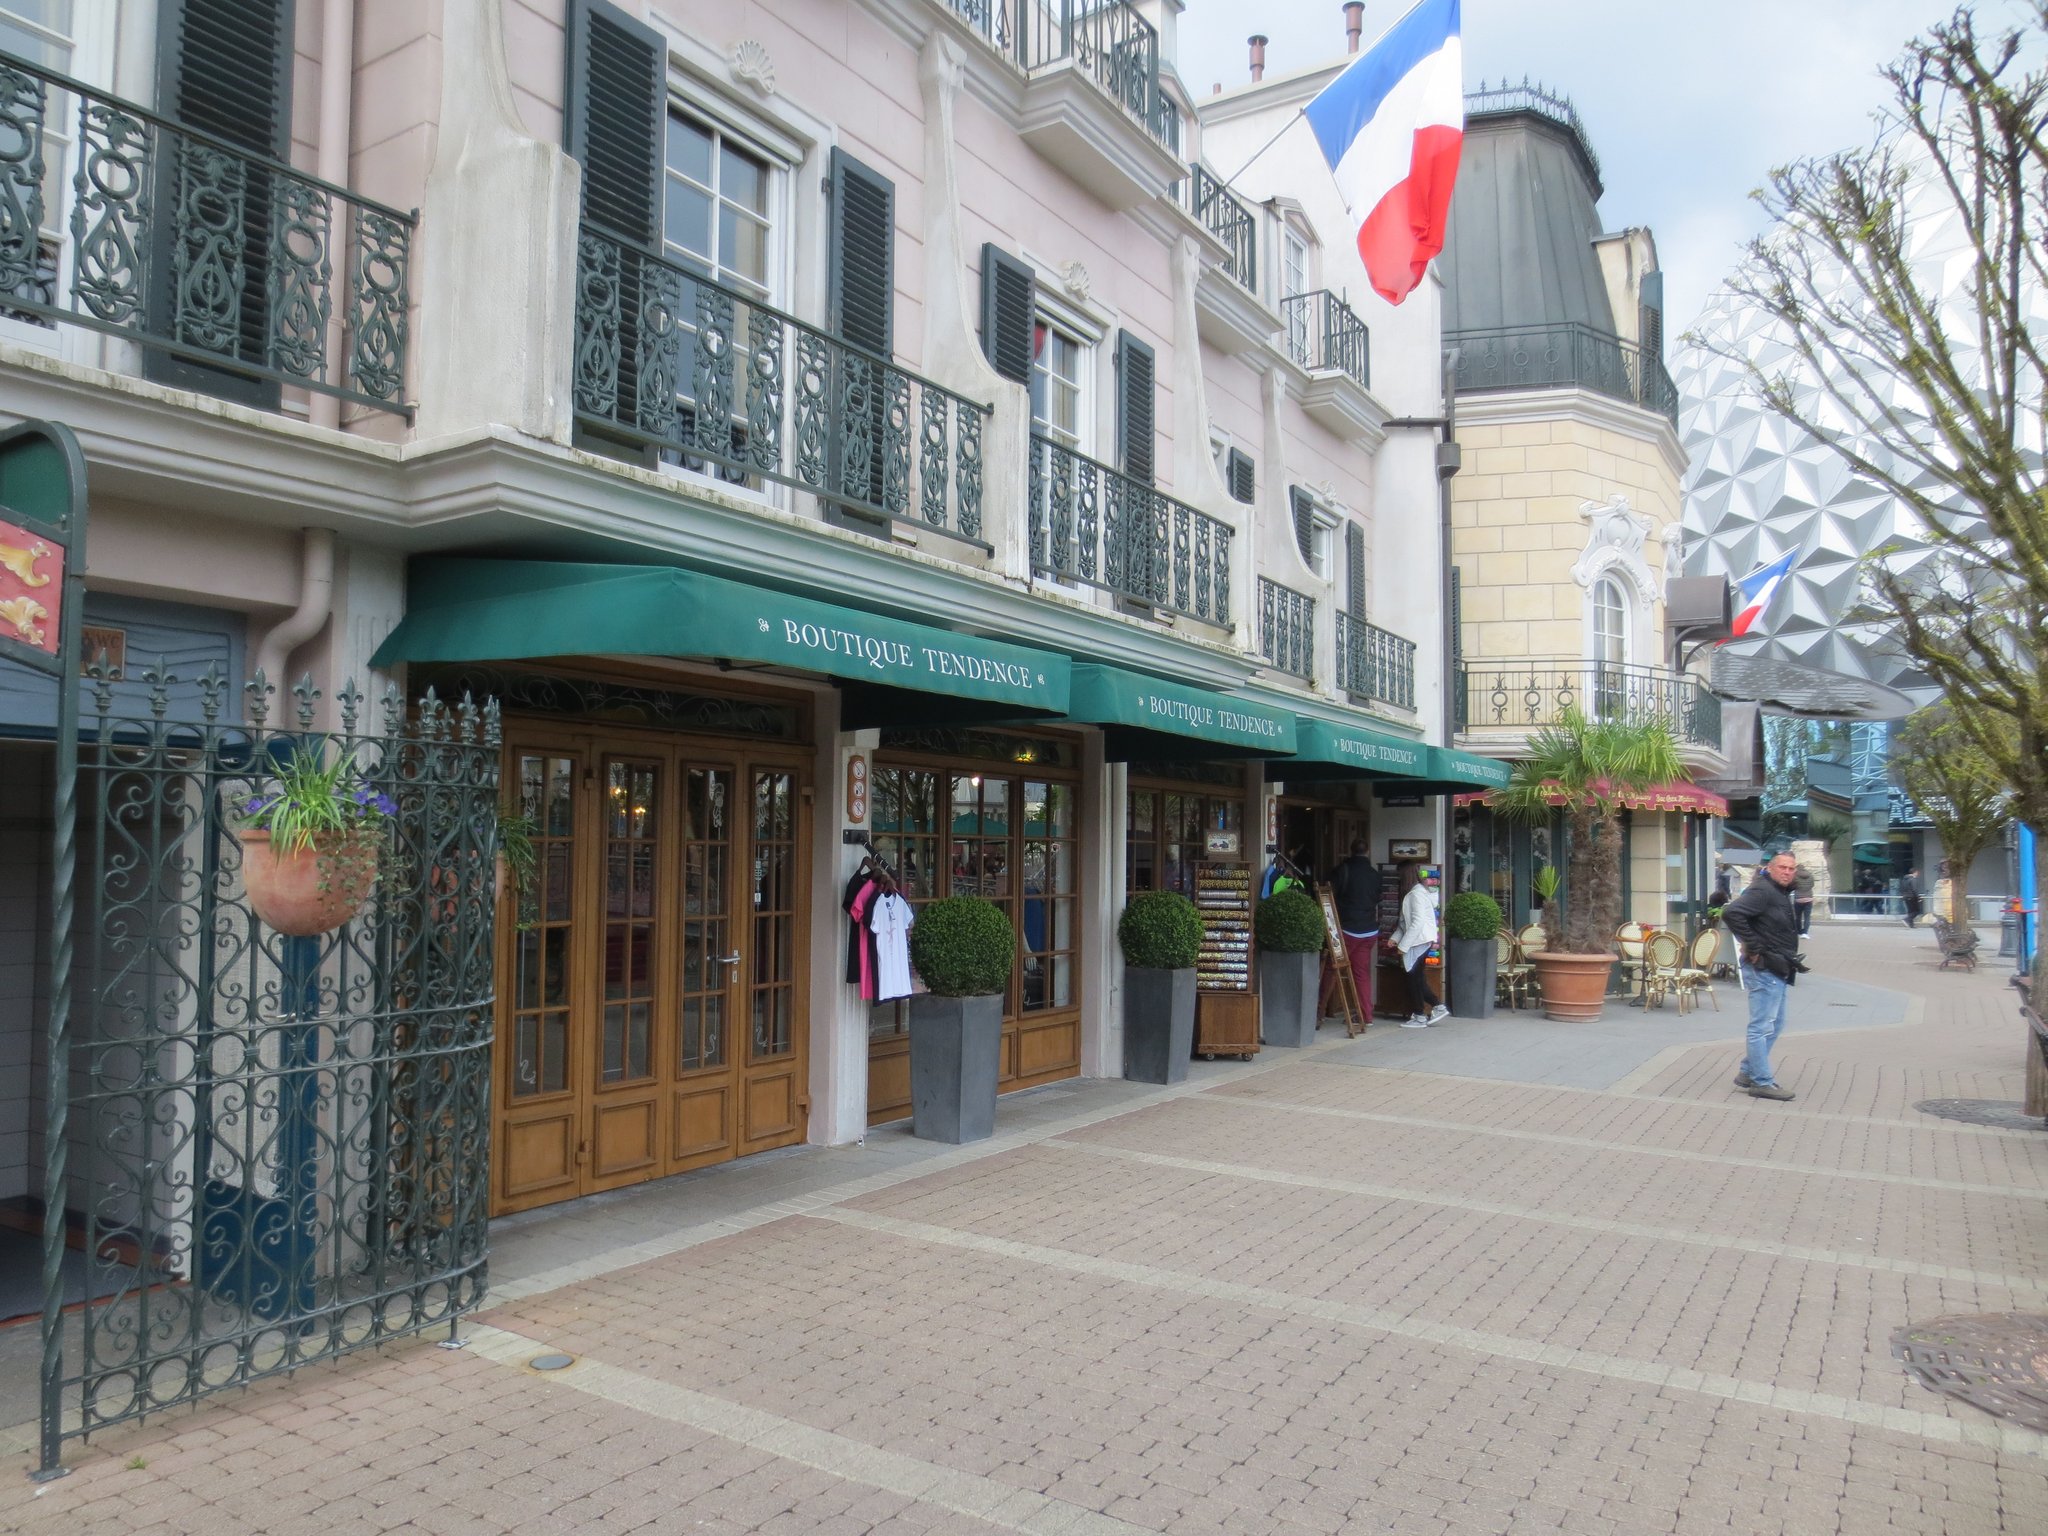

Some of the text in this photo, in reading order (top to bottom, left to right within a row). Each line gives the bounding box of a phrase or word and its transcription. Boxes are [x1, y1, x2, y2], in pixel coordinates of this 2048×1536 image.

[96, 633, 120, 649] WC
[783, 619, 1033, 689] BOUTIQUE TENDENCE
[1150, 696, 1276, 737] BOUTIQUE TENDENCE
[1340, 738, 1413, 764] BOUTIQUE TENDENCE
